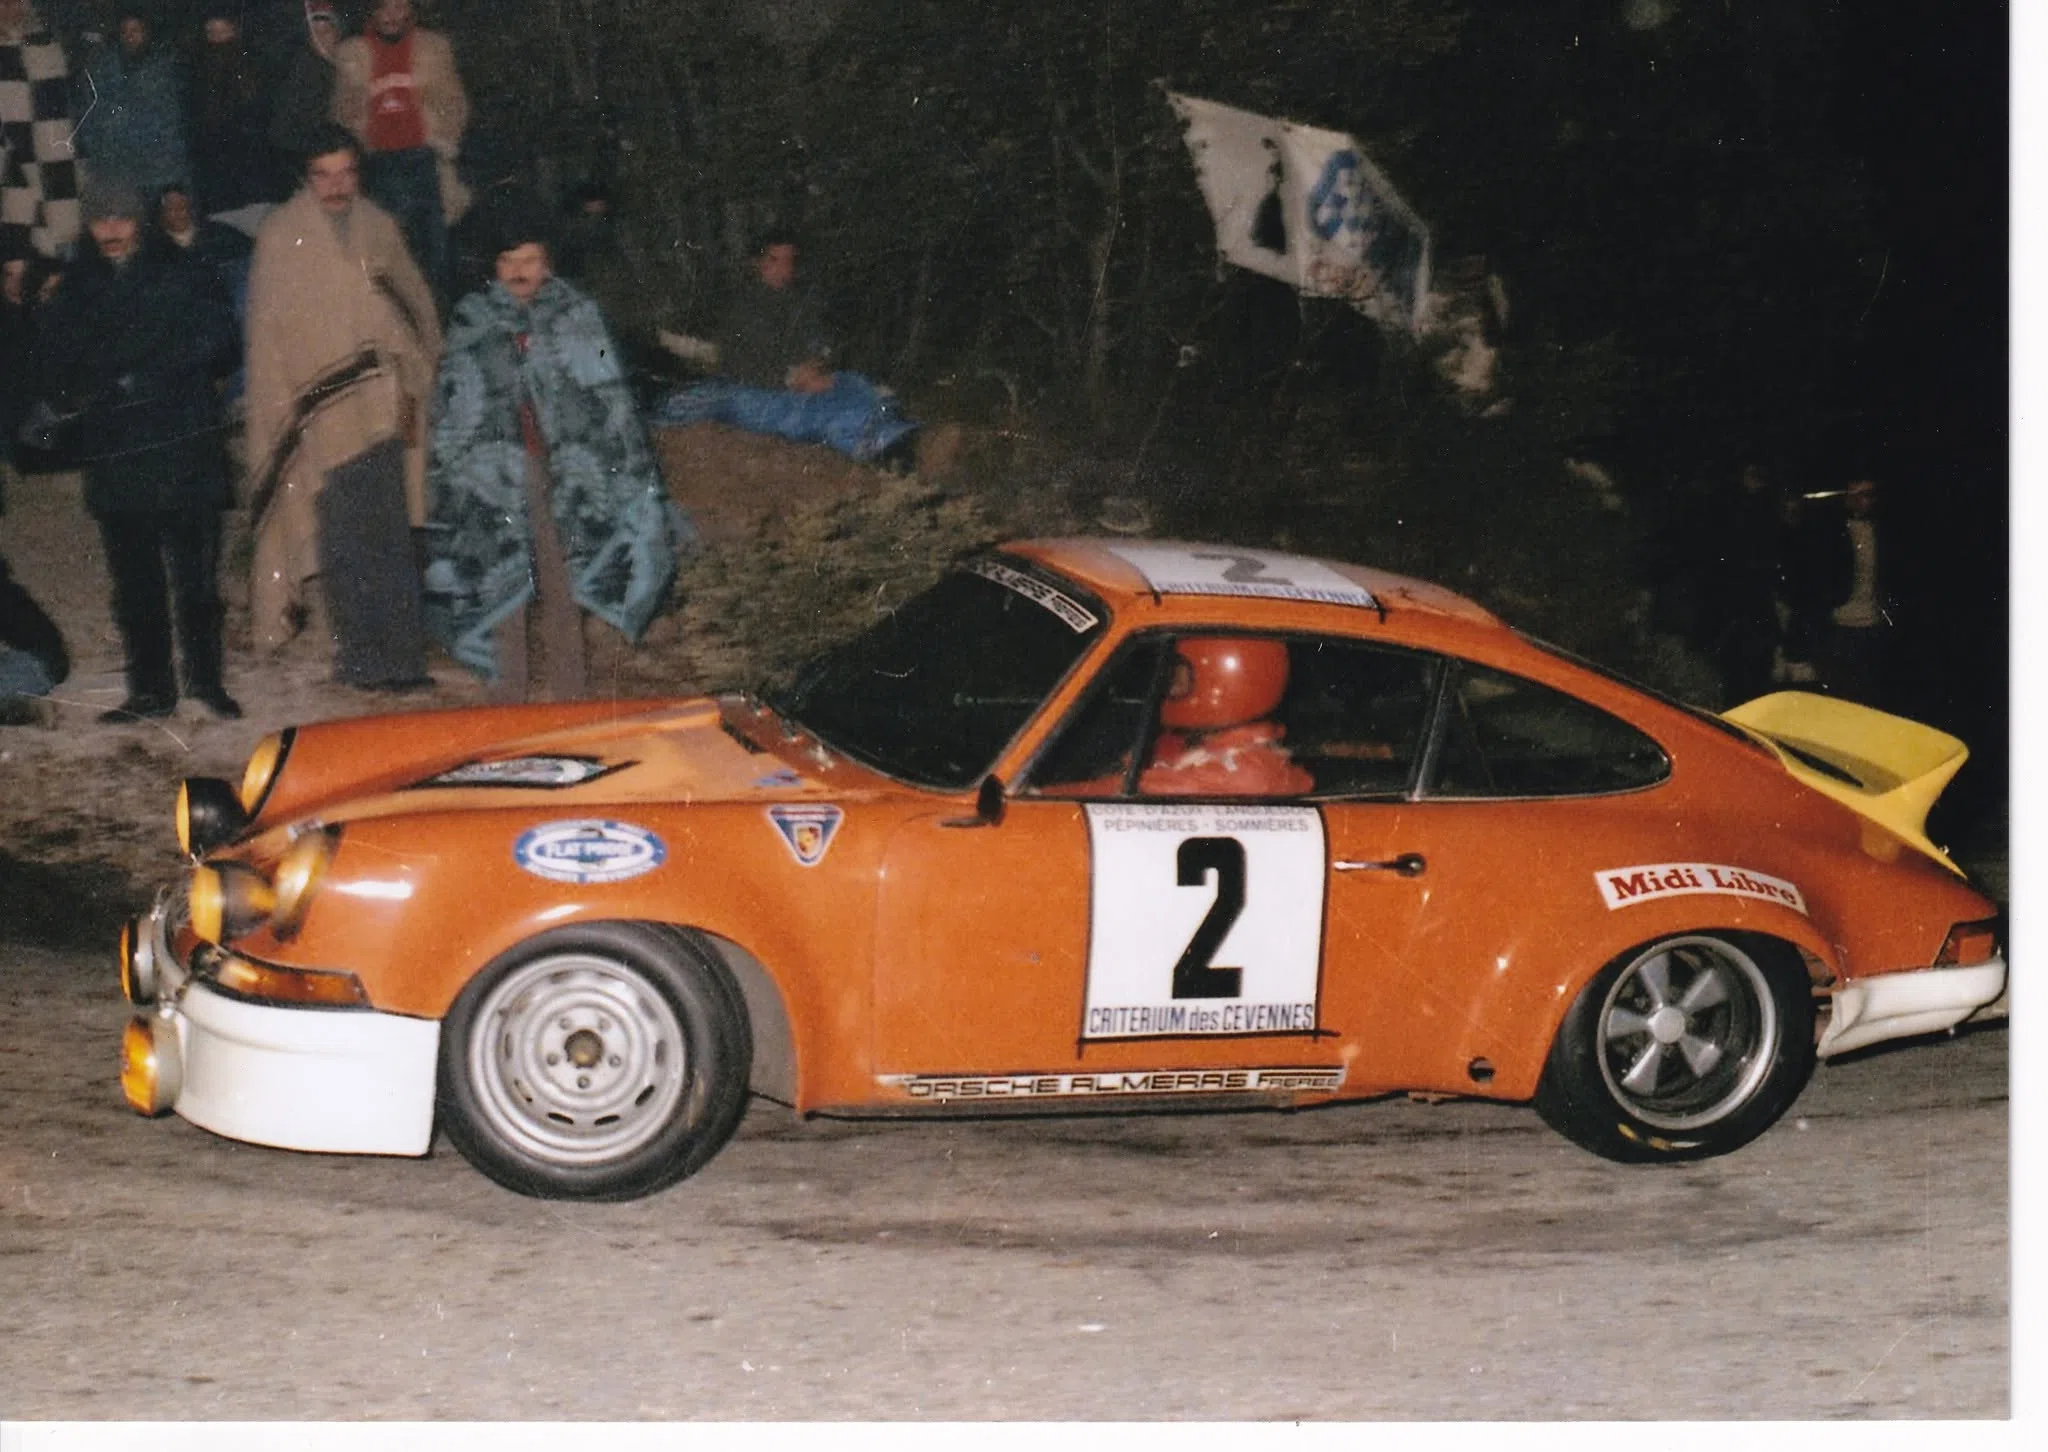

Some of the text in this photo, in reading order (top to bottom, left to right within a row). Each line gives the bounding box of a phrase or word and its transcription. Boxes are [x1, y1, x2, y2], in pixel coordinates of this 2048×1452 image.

[1190, 552, 1293, 587] 2
[1608, 868, 1797, 905] Midi Libre
[1172, 837, 1247, 1000] 2
[1090, 1003, 1313, 1033] CRITERIUM des CEVENNES
